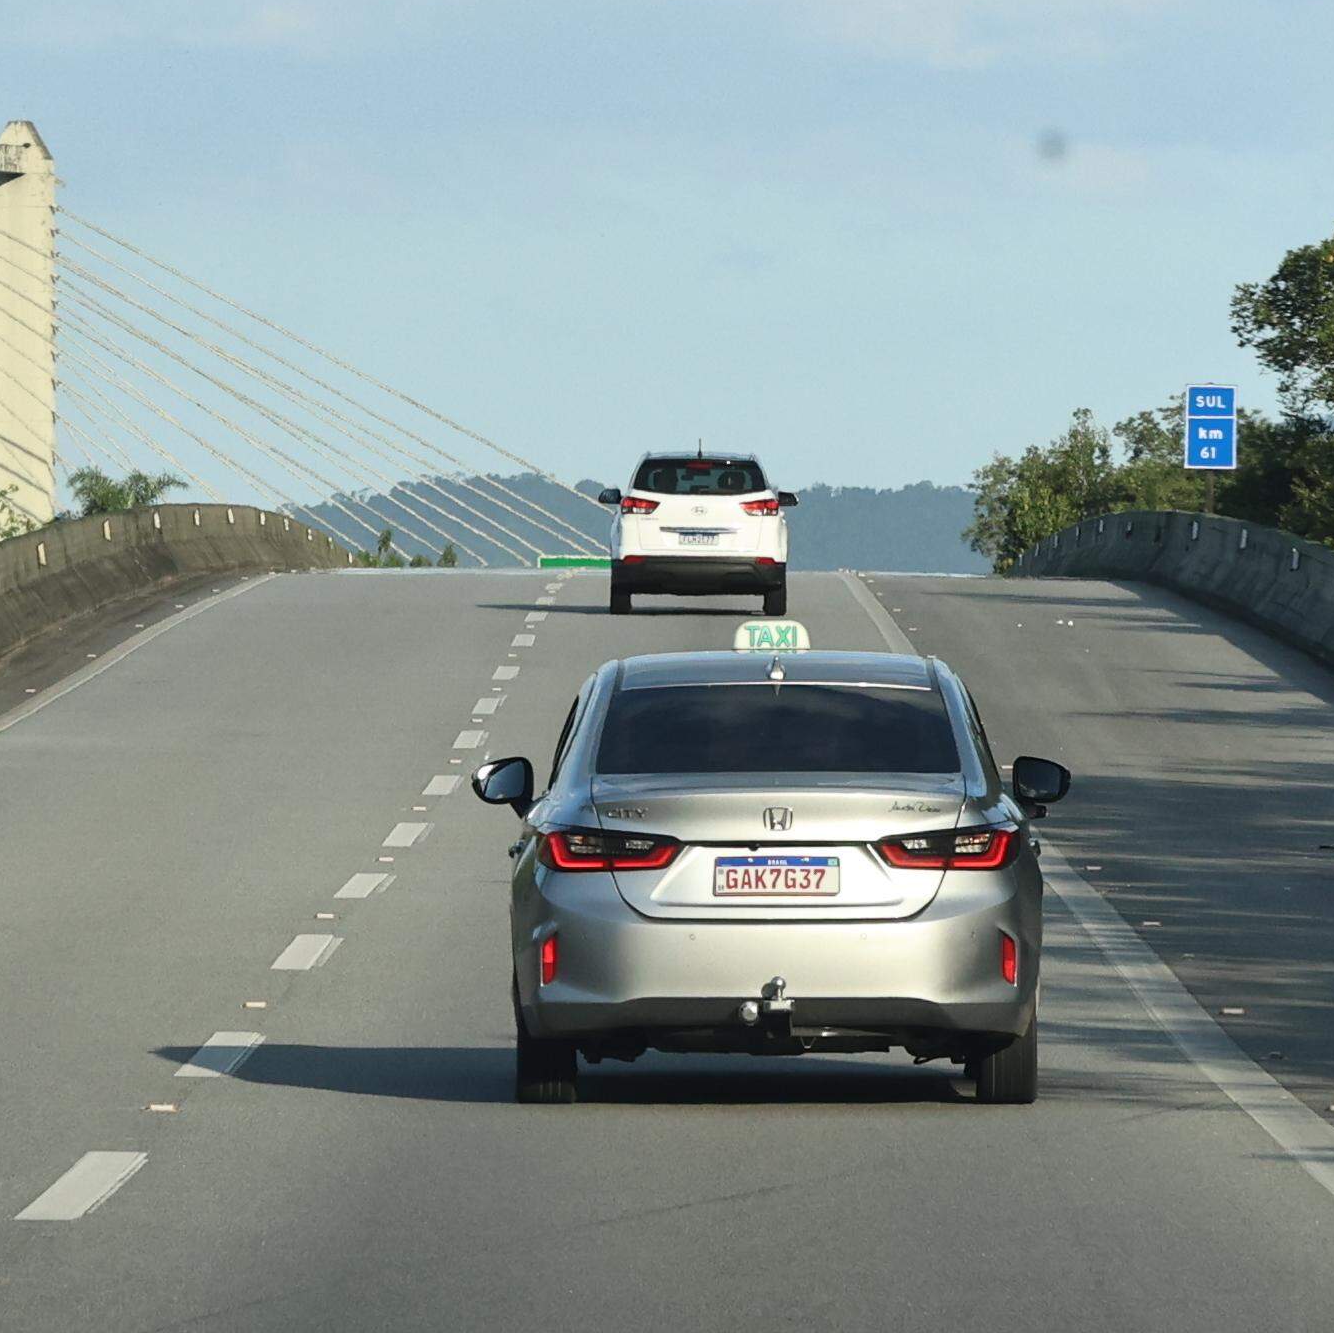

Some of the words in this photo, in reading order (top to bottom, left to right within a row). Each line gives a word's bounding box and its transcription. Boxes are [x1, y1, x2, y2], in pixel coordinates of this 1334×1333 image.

[1195, 395, 1226, 409] SUL
[1198, 427, 1223, 440] km
[1200, 446, 1217, 459] 61
[744, 625, 798, 647] TAXI
[726, 868, 826, 889] GAK7G37
